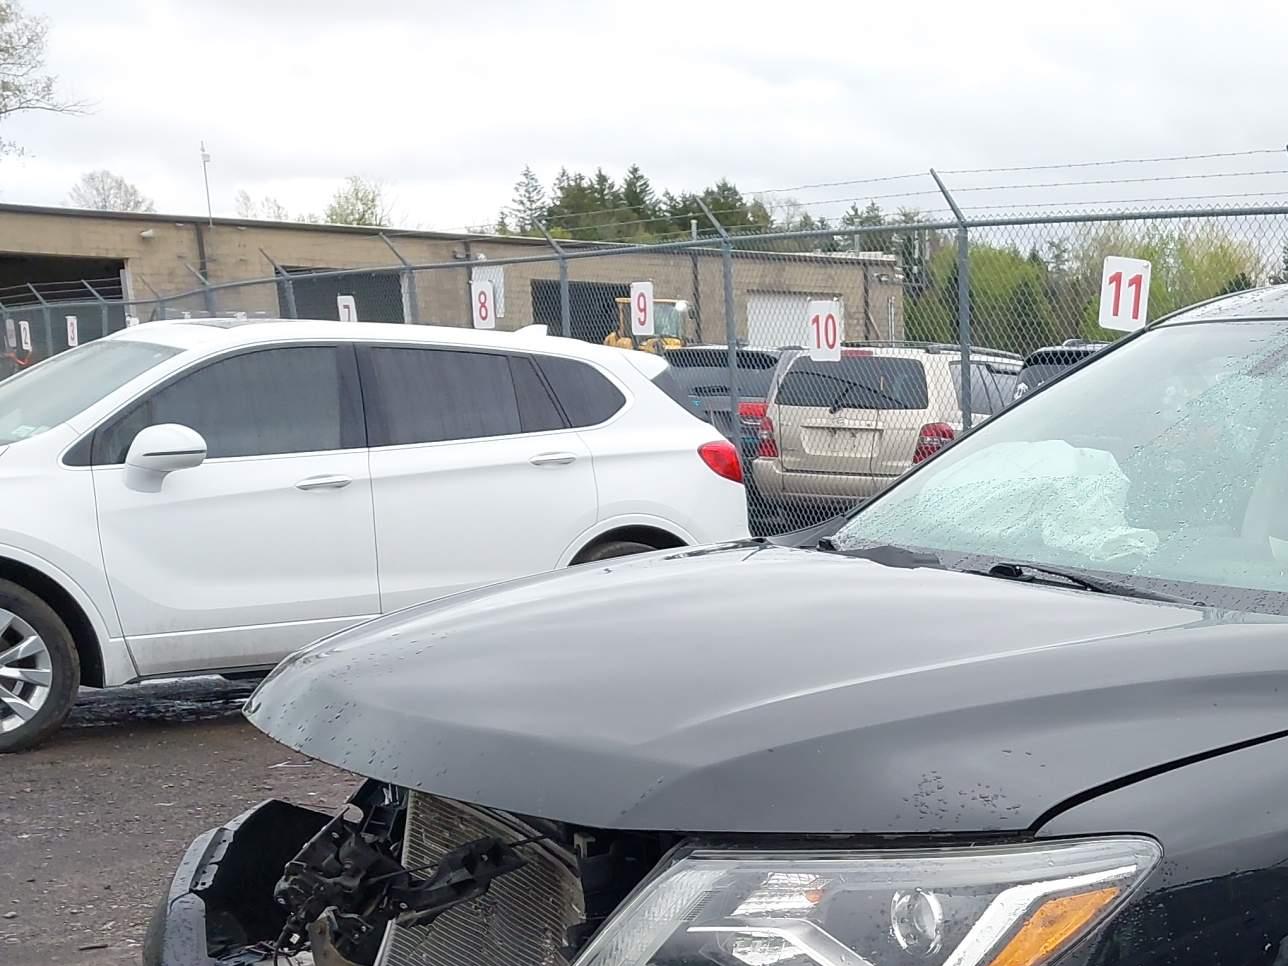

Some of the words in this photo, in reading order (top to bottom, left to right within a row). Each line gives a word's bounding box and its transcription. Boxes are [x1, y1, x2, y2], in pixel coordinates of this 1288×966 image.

[478, 291, 488, 321] 8
[637, 292, 646, 326] 9
[1108, 272, 1142, 320] 11
[22, 326, 29, 345] 2
[811, 313, 836, 349] 10
